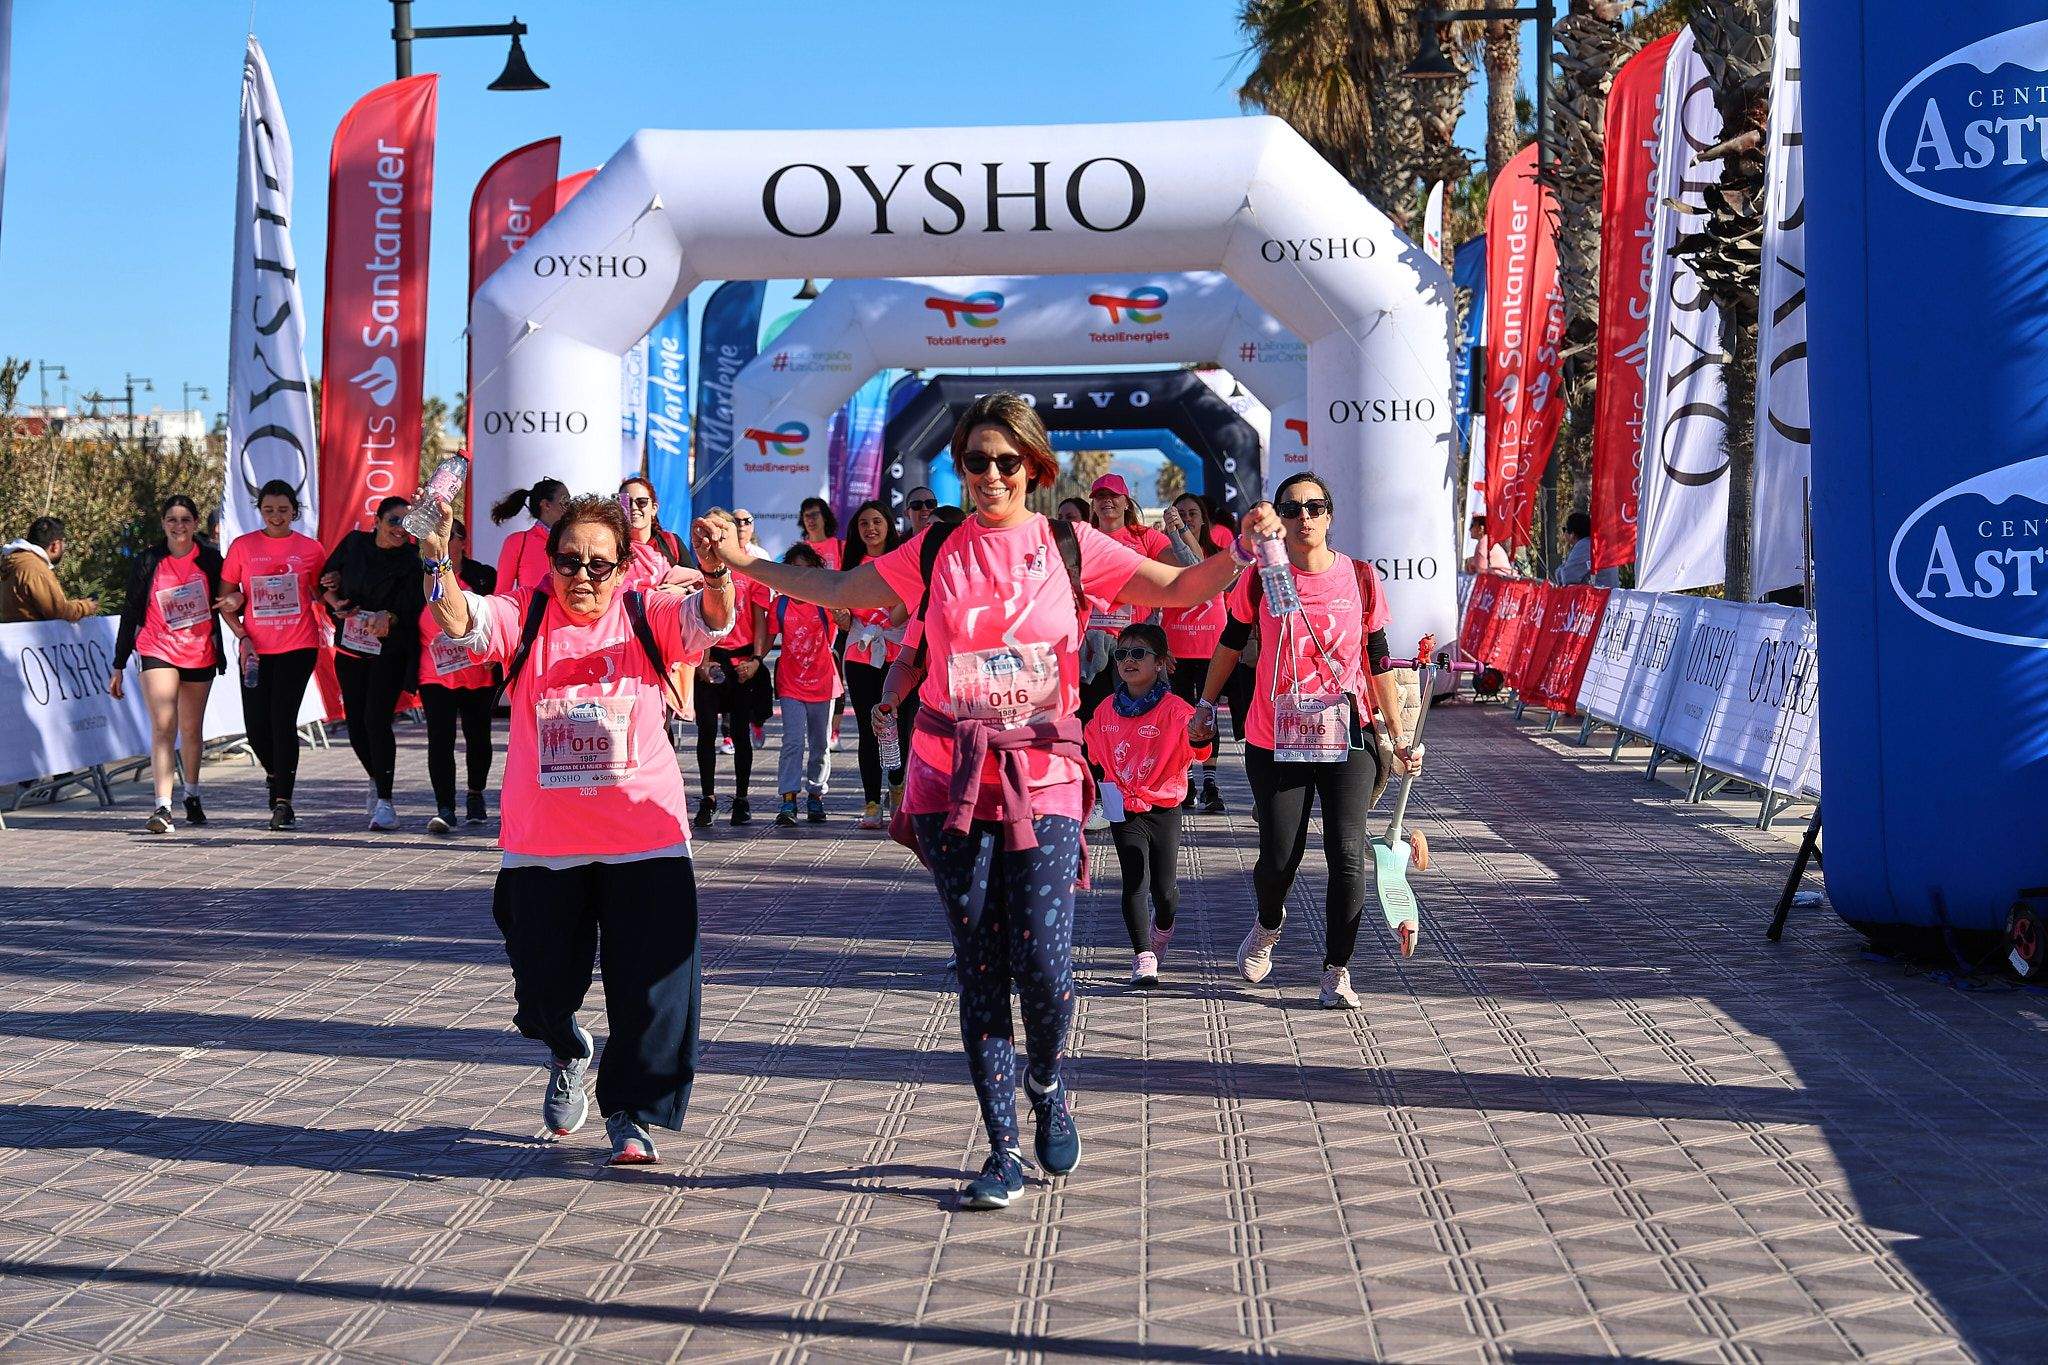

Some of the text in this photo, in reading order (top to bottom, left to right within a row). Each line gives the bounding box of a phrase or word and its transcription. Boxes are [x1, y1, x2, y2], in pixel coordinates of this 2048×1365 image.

[762, 158, 1146, 238] OYSHO
[362, 139, 404, 348] Santander
[1261, 237, 1376, 264] OYSHO
[534, 255, 647, 279] OYSHO
[1499, 199, 1528, 369] Santander
[926, 335, 1006, 348] TotalEnergies
[1088, 331, 1170, 345] TotalEnergies
[648, 336, 689, 456] Marlene
[702, 344, 744, 454] Marlene
[975, 390, 1151, 409] OLVO
[484, 411, 588, 435] OYSHO
[1329, 399, 1436, 424] OYSHO
[744, 463, 810, 474] TotalEnergies
[1978, 519, 2048, 537] CEN
[1366, 556, 1438, 582] SHO
[1916, 525, 2048, 599] AST
[1686, 624, 1737, 692] OYSHO
[21, 640, 112, 705] OYSHO
[989, 690, 1028, 707] 016
[1300, 724, 1326, 735] 016
[571, 737, 609, 752] 016
[580, 754, 597, 763] 1987
[549, 774, 581, 783] OYSHO
